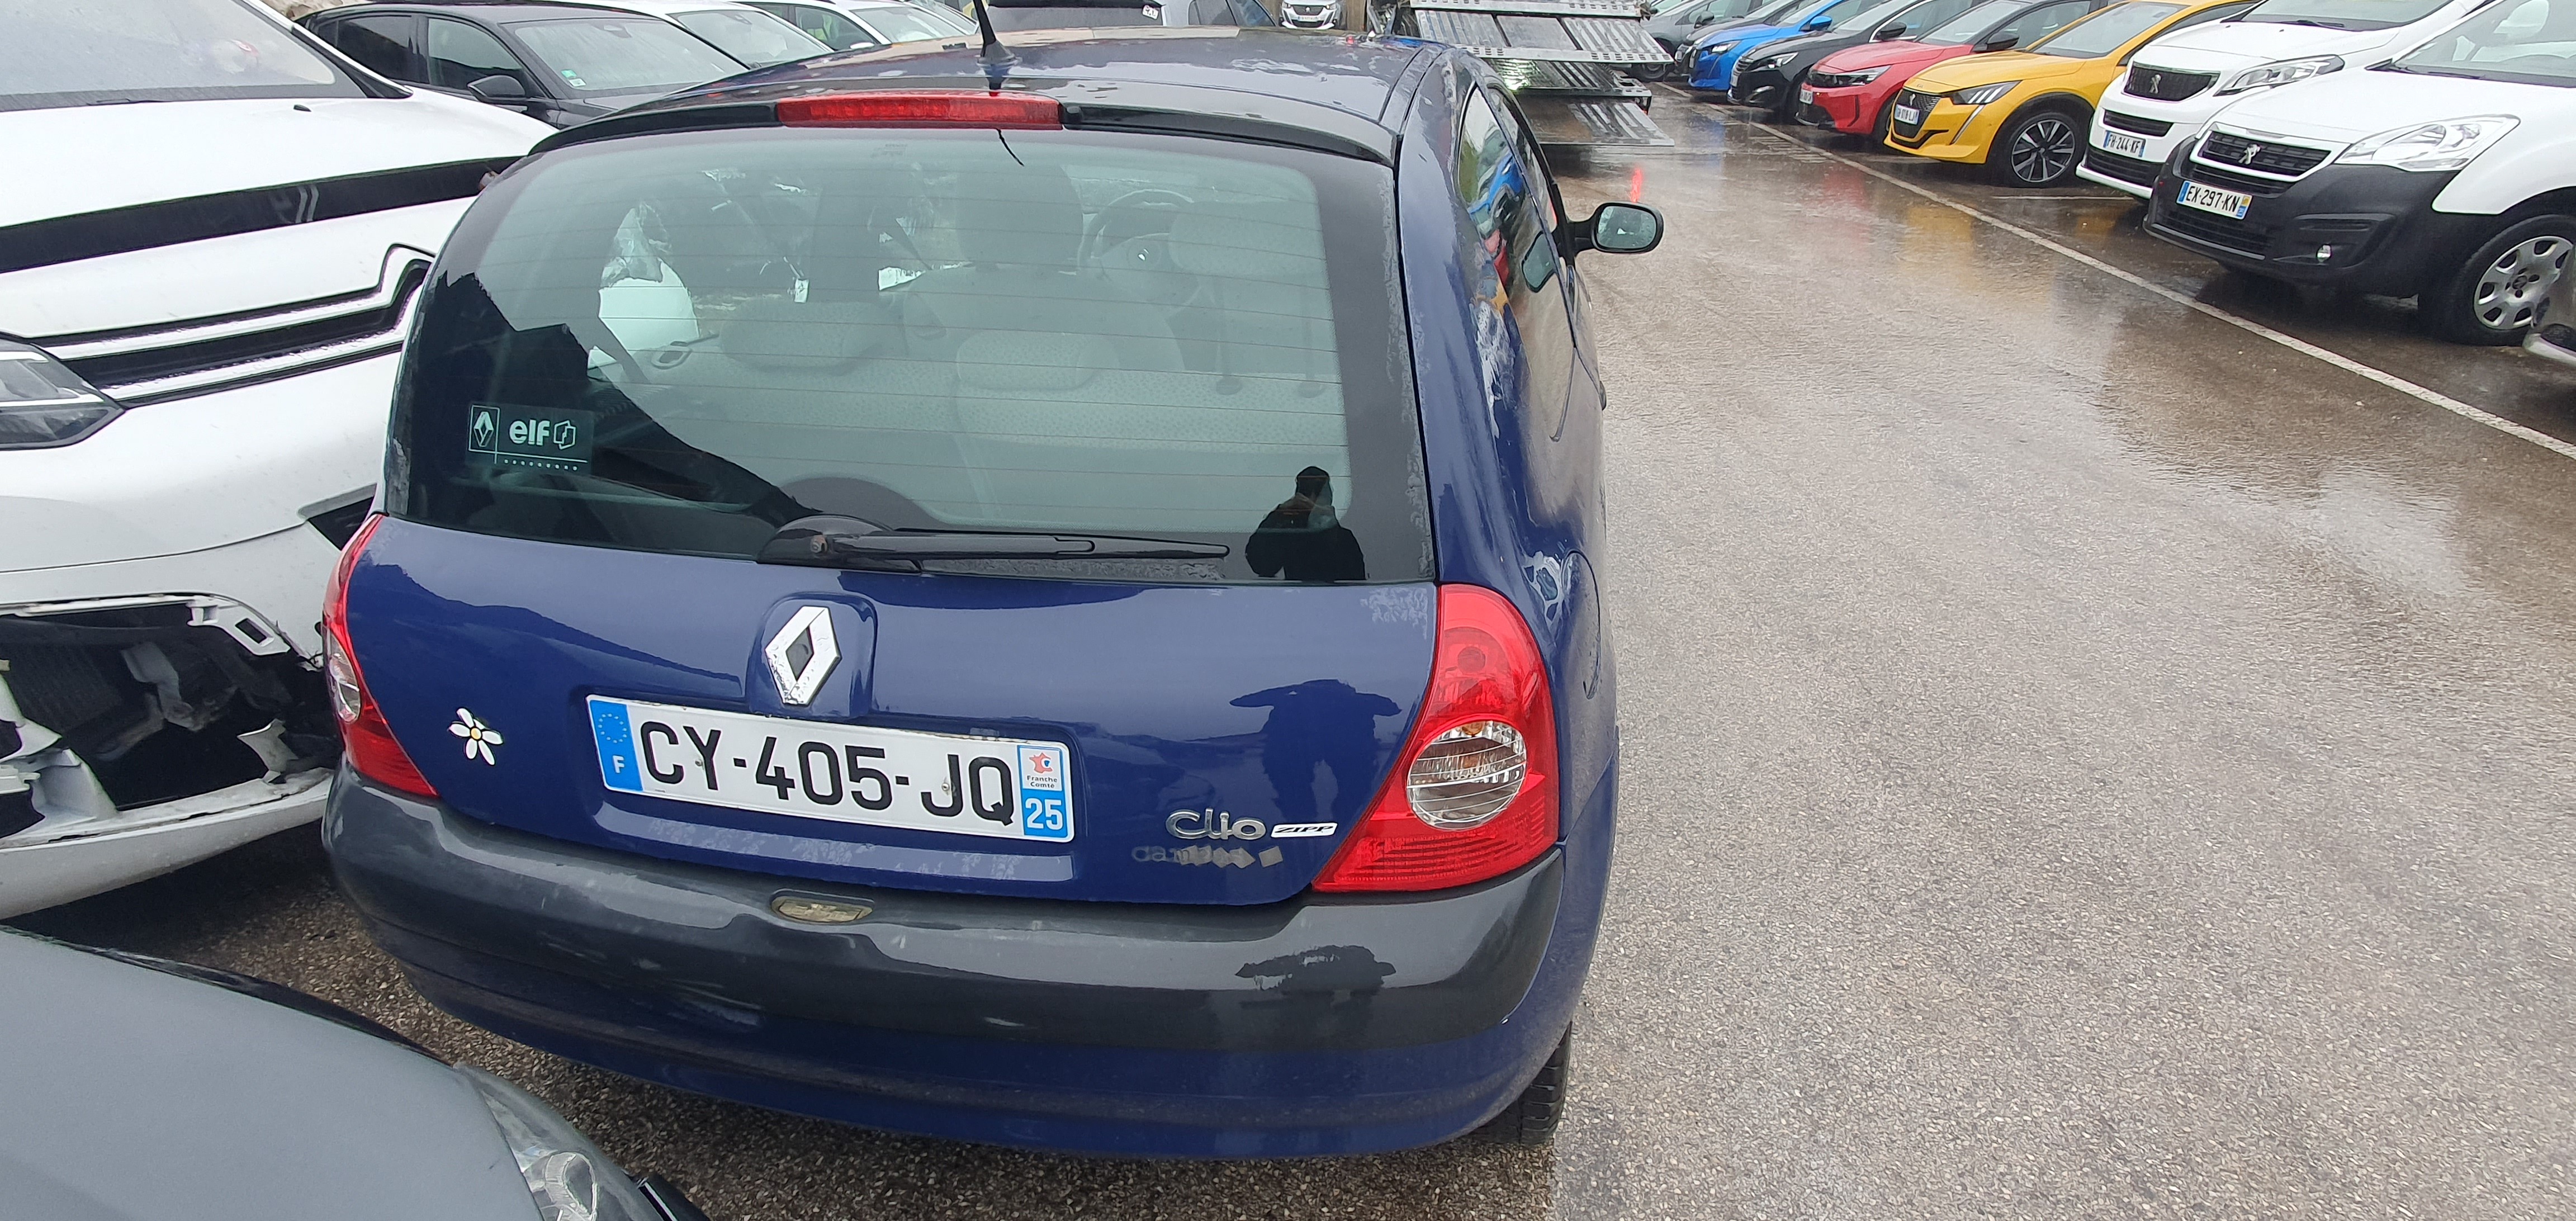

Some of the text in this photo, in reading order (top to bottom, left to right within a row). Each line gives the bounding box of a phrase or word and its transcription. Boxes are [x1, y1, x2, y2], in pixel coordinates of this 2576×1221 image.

[2186, 186, 2241, 212] EX-297-KN
[509, 419, 550, 446] elf
[612, 755, 625, 774] F
[640, 721, 1015, 826] CY-405-JQ
[1025, 798, 1063, 831] 25
[1165, 807, 1267, 840] Clio
